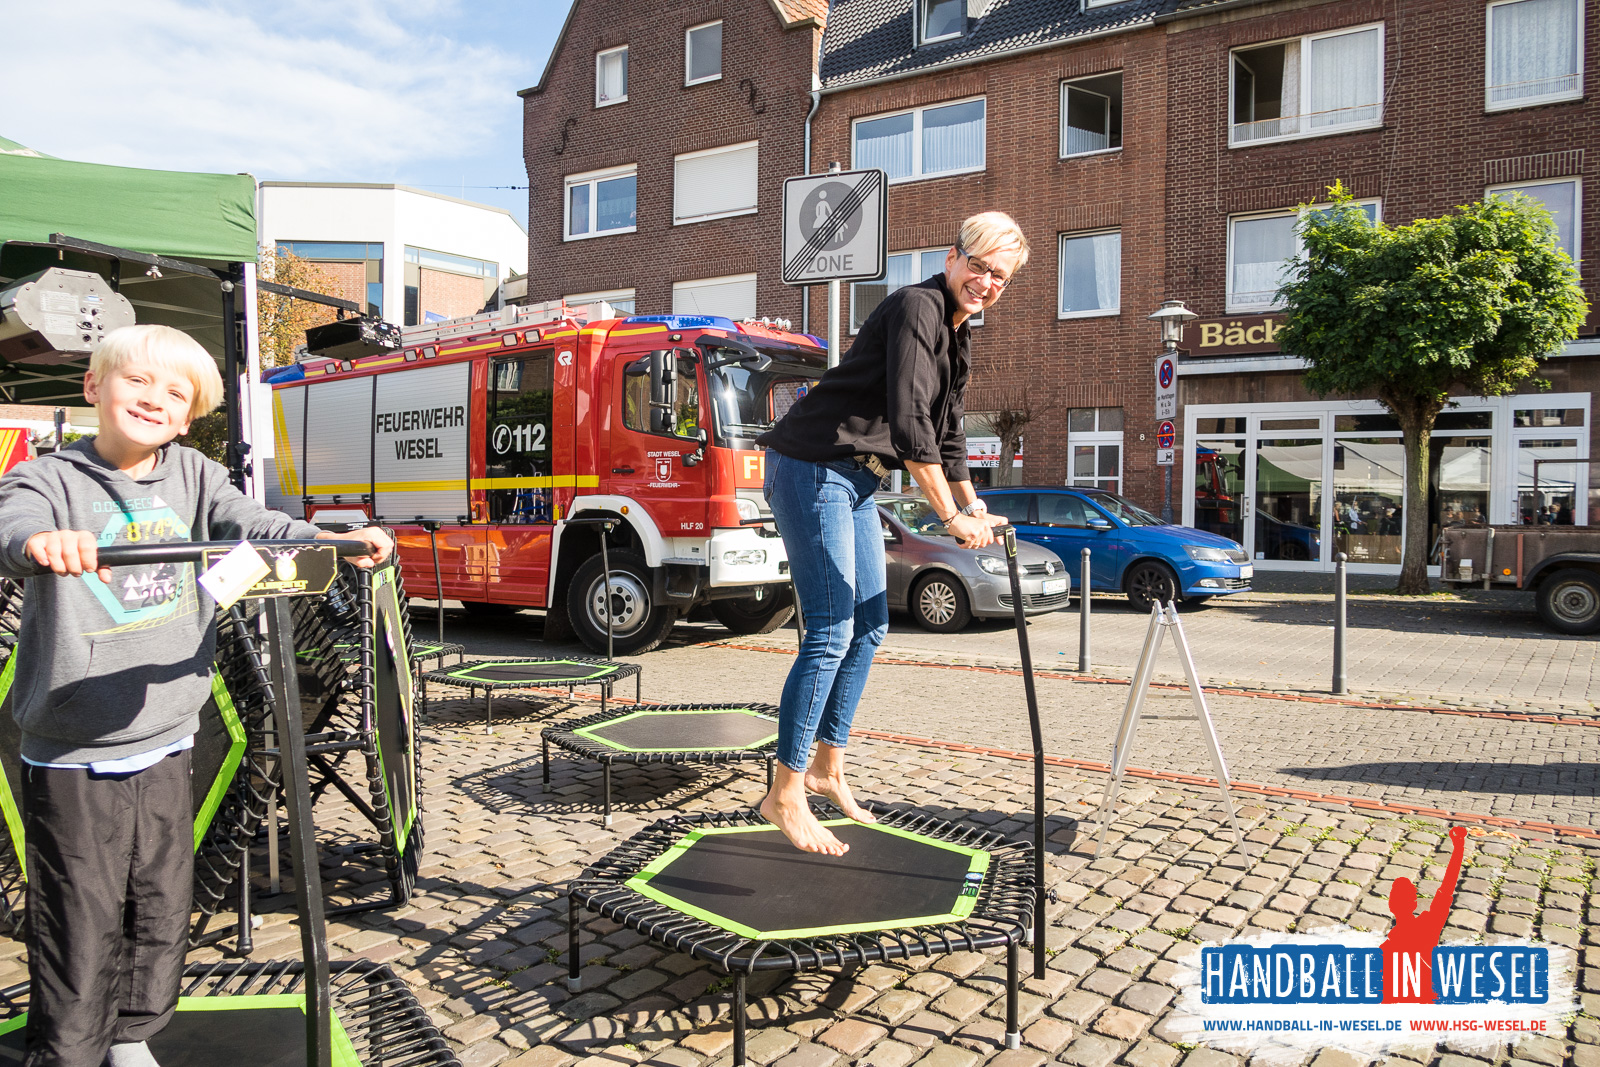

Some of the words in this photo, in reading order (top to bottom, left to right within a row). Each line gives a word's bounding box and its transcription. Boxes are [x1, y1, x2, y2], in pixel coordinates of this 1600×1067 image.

[806, 254, 853, 274] ZONE
[376, 405, 465, 433] FEUERWEHR
[513, 423, 546, 452] 112
[395, 438, 443, 460] WESEL
[681, 522, 694, 530] HLF
[695, 522, 704, 530] 20
